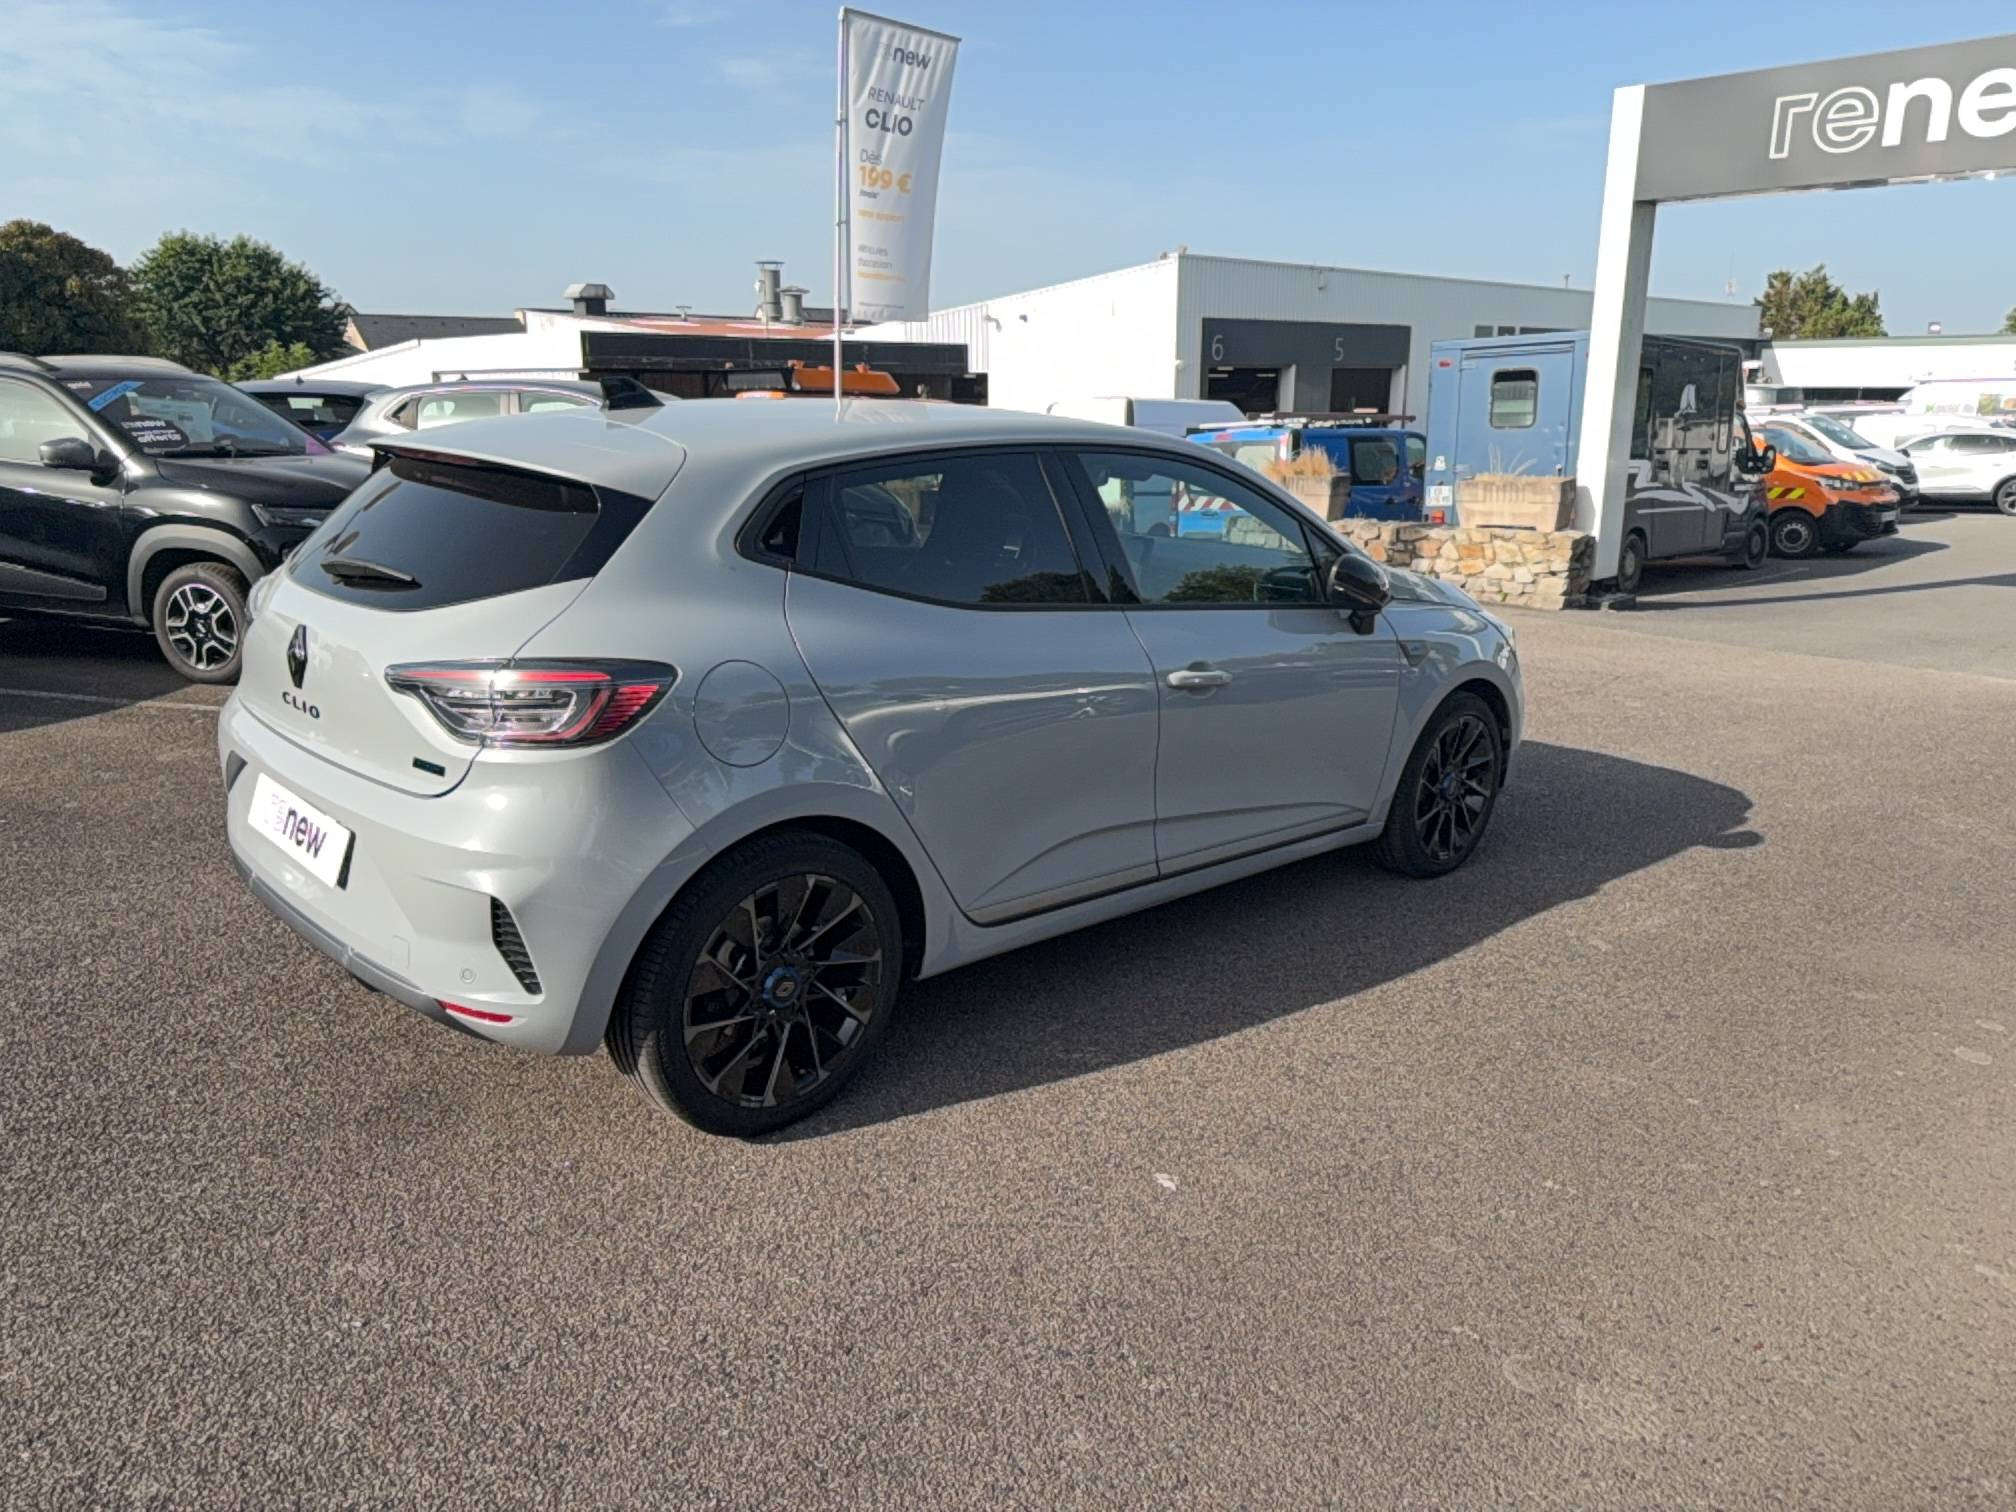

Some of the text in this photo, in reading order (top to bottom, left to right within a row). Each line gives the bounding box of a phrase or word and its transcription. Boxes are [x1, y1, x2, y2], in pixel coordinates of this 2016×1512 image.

[867, 85, 925, 112] RENAULT
[864, 108, 913, 137] CLIO
[1211, 334, 1223, 361] 6
[1334, 337, 1344, 361] 5
[282, 691, 320, 719] CLIO
